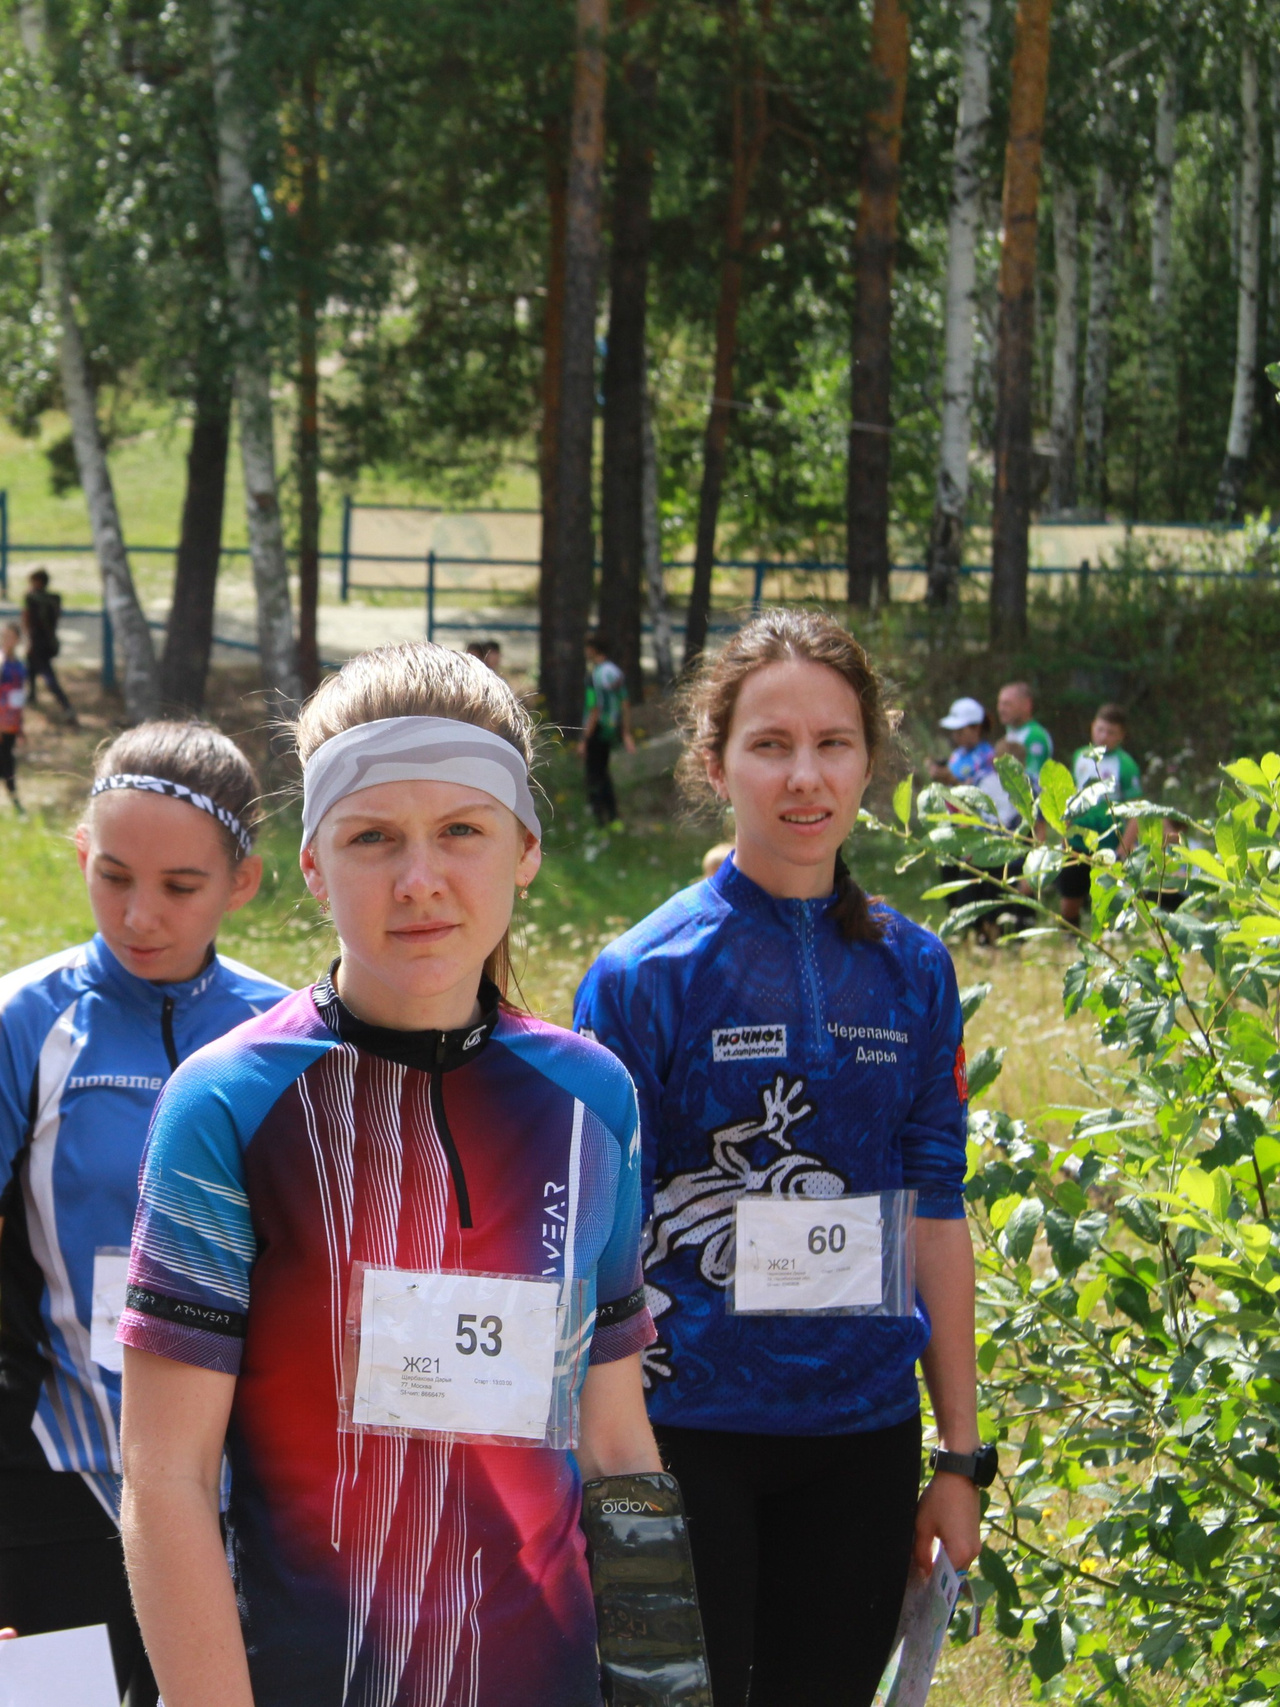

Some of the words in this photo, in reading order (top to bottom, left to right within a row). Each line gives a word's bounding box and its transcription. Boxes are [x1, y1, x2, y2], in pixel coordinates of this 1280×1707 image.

[827, 1022, 909, 1043] Черепанова
[855, 1046, 897, 1065] Дарья
[69, 1074, 163, 1091] noname
[807, 1223, 846, 1255] 60
[767, 1258, 796, 1271] Ж21
[455, 1313, 503, 1357] 53
[403, 1356, 440, 1374] Ж21
[401, 1374, 434, 1383] Щербакова
[434, 1376, 452, 1384] Дарья
[601, 1497, 653, 1514] vapro
